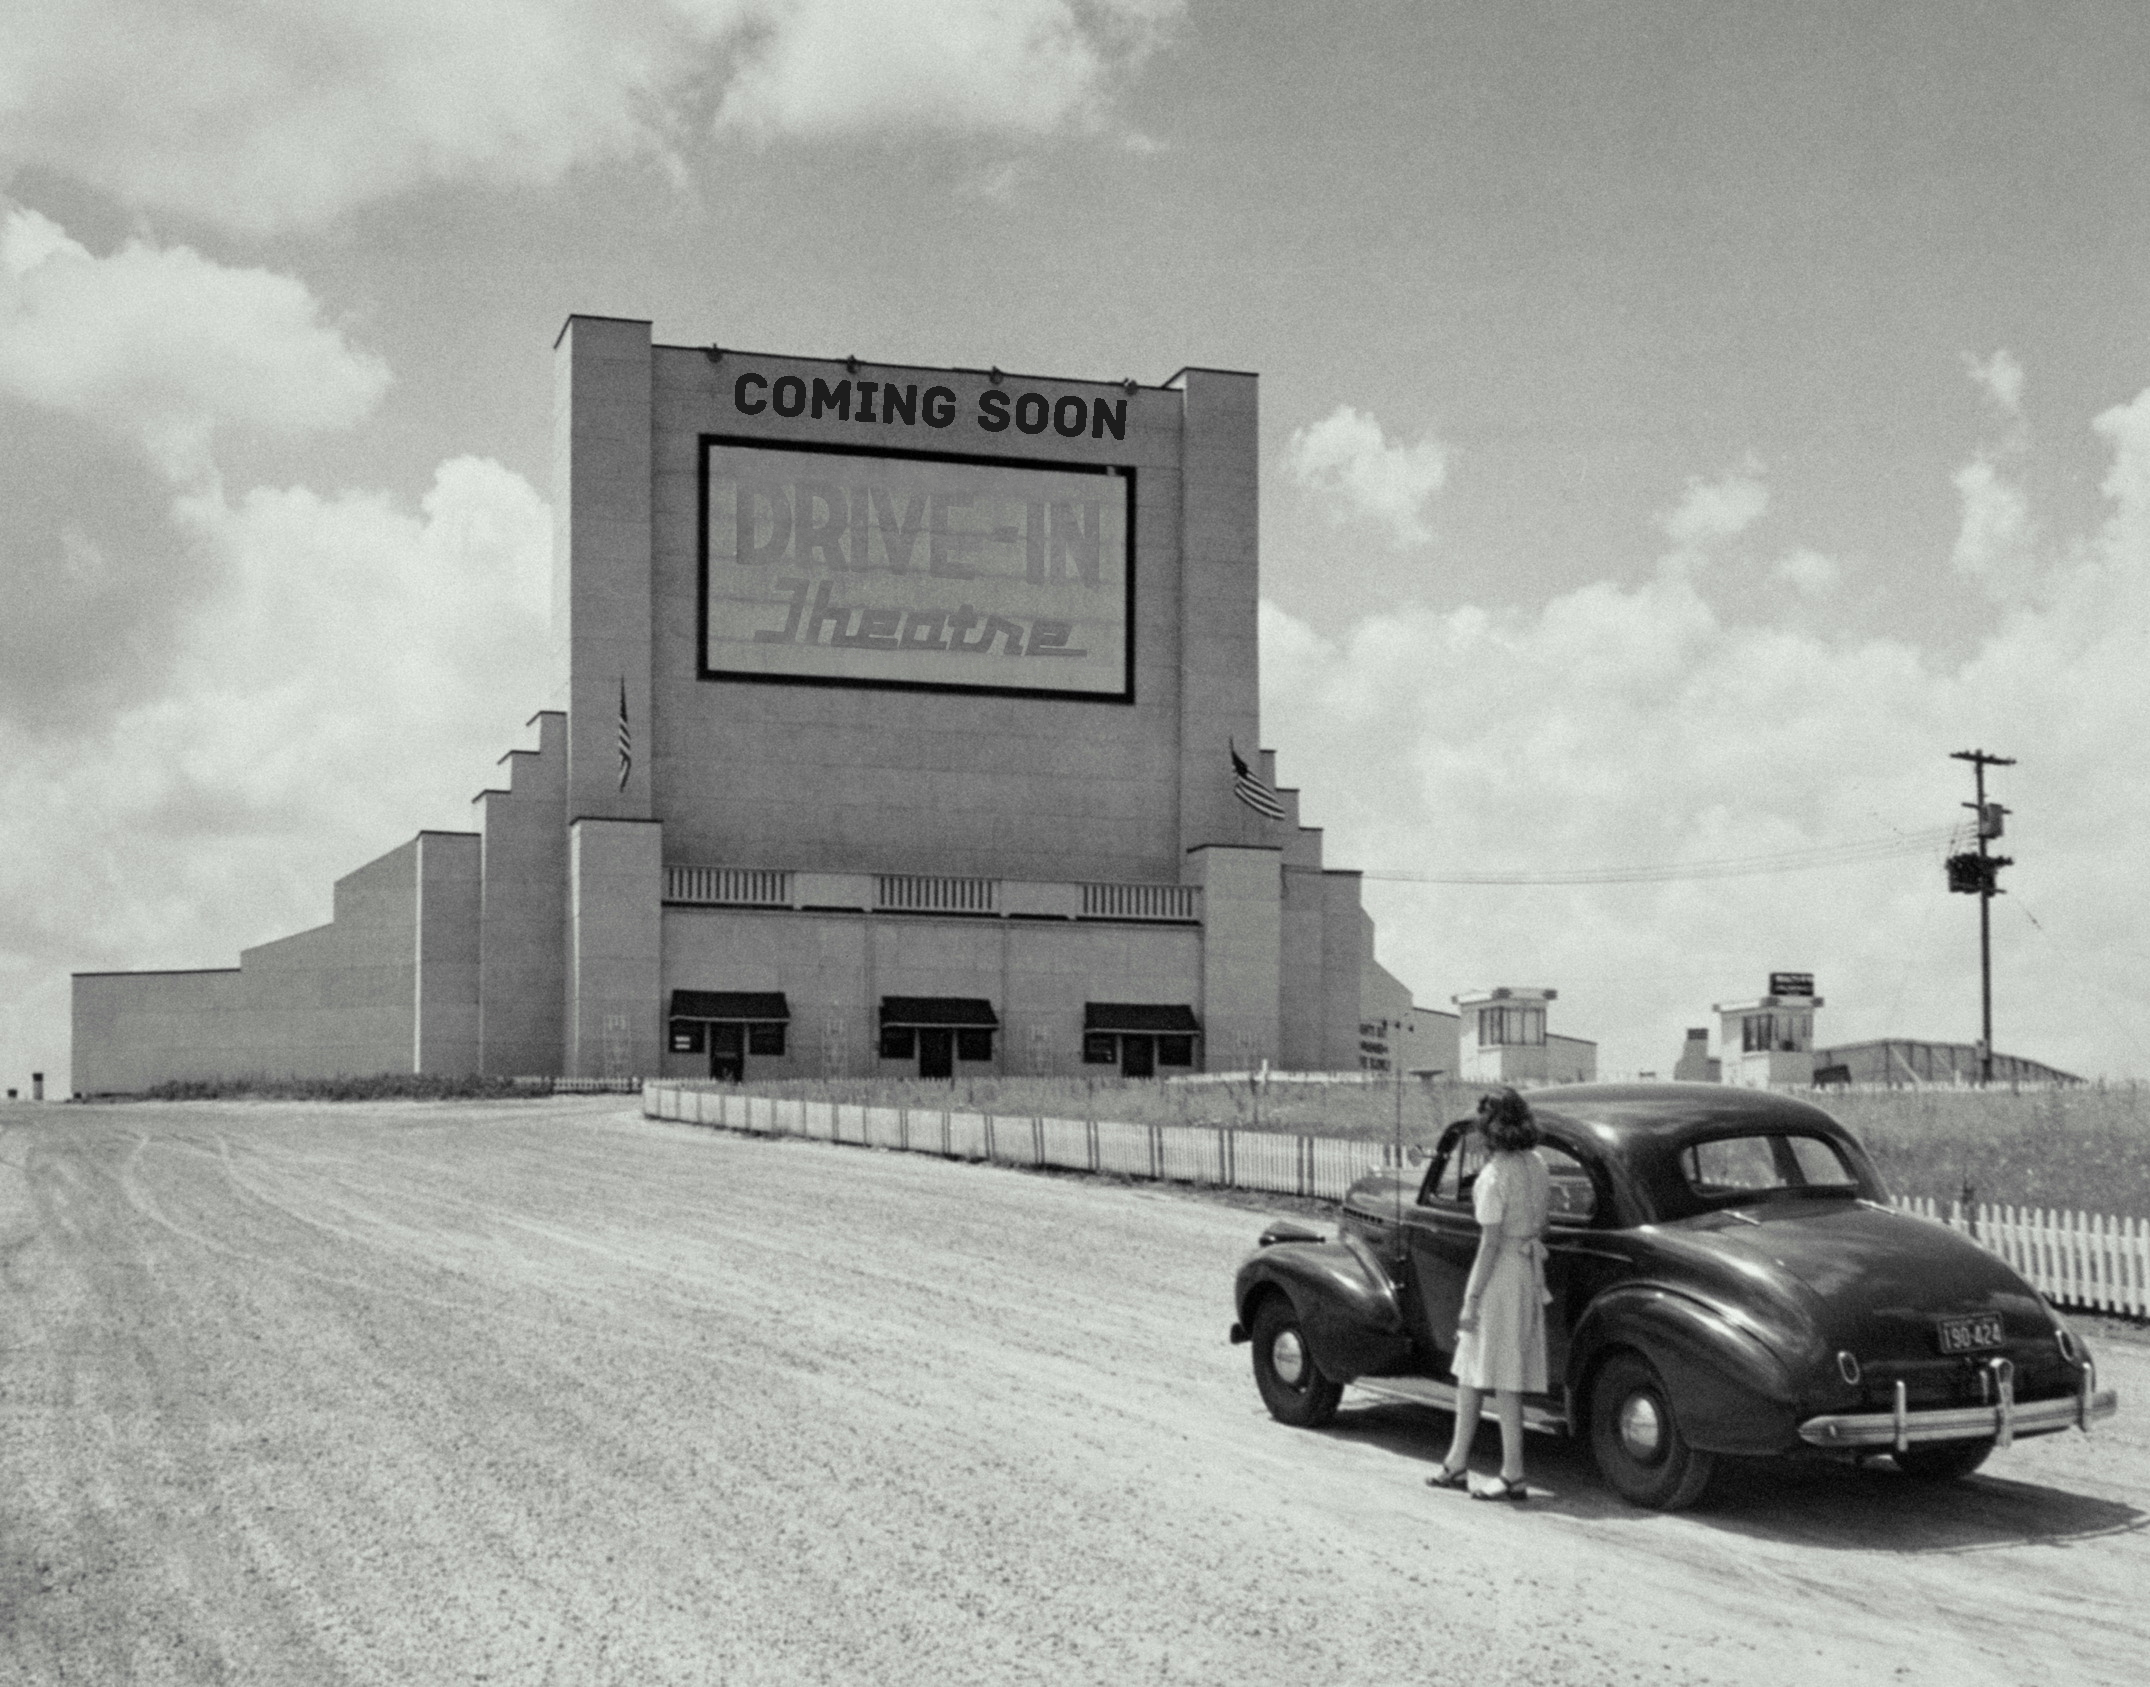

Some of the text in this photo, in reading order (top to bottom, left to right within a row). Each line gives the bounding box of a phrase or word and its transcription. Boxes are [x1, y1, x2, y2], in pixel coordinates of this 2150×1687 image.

[734, 372, 1128, 441] COMING SOON
[735, 479, 1101, 588] DRIVE-IN
[752, 576, 1088, 657] Theatre
